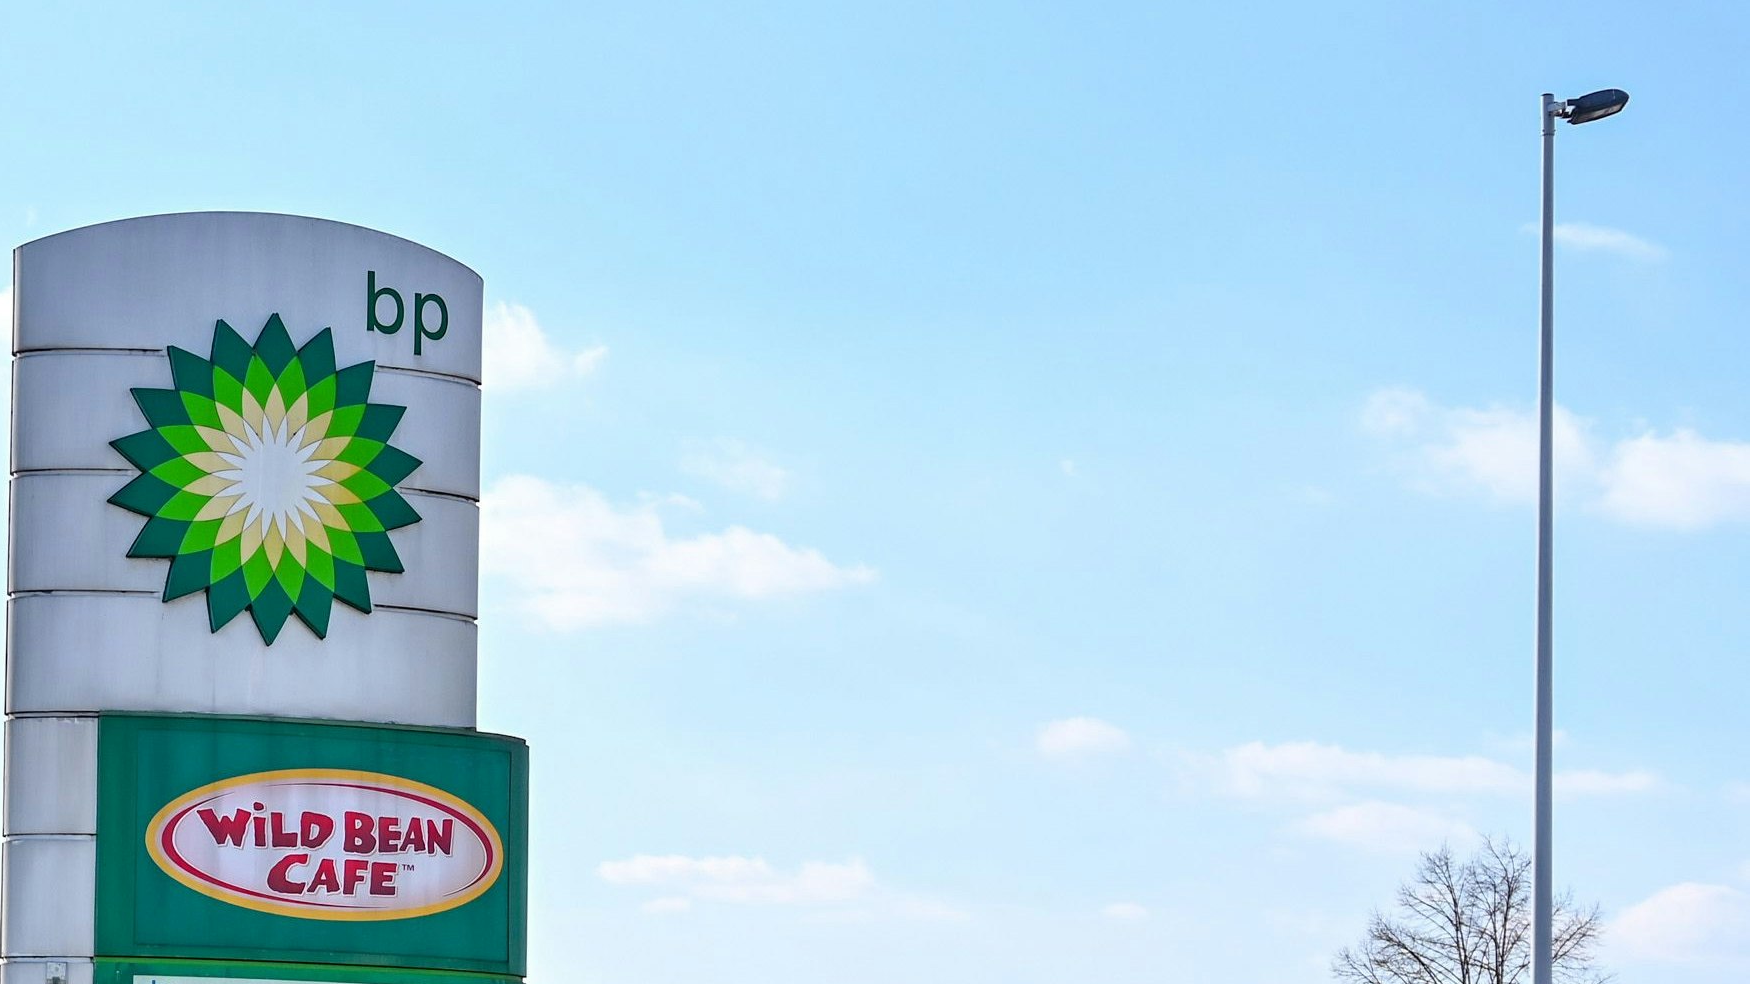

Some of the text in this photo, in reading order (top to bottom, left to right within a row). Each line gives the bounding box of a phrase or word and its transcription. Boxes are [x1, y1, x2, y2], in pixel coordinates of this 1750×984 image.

[366, 270, 449, 356] bp
[342, 811, 454, 855] BEAN
[266, 853, 398, 896] CAFE
